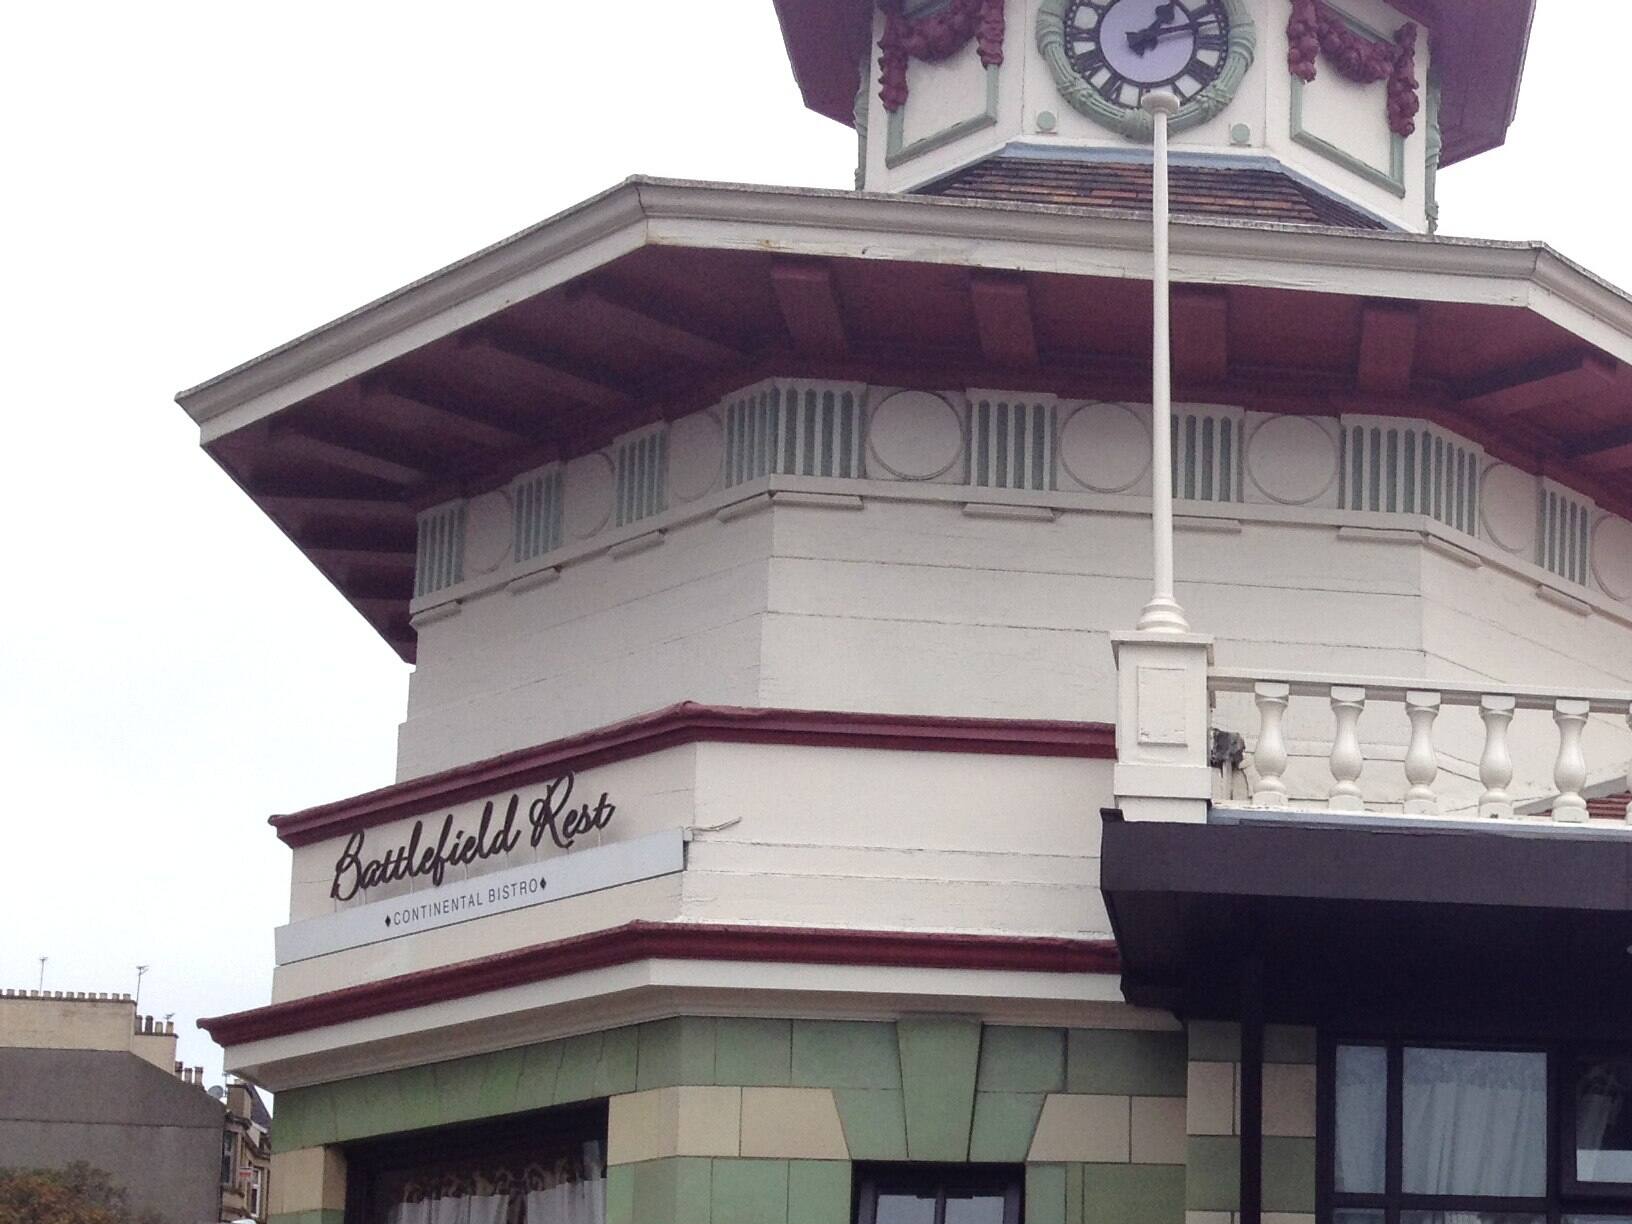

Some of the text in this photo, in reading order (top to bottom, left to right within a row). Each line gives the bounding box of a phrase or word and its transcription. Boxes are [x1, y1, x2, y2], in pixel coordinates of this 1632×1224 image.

[330, 771, 617, 901] Battlefield Rest
[393, 879, 539, 926] CONTINENTAL BISTRO
